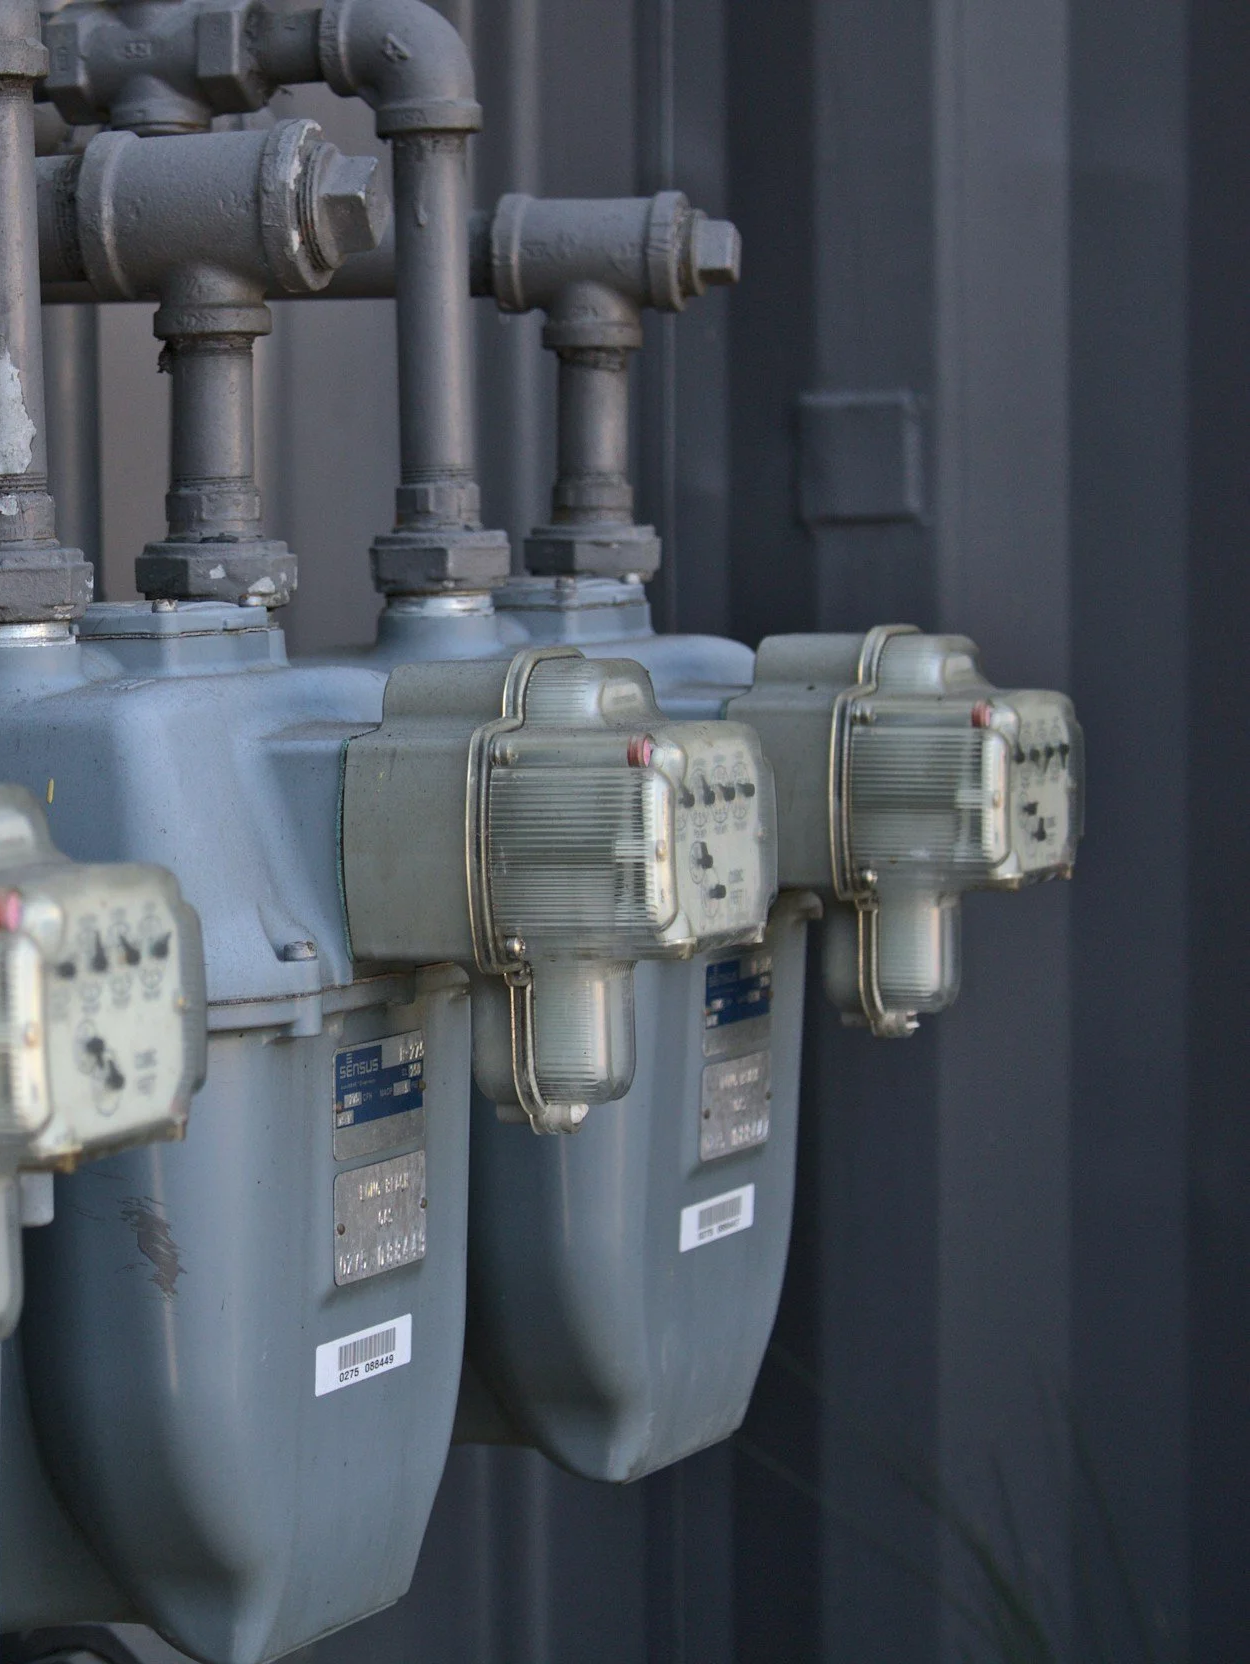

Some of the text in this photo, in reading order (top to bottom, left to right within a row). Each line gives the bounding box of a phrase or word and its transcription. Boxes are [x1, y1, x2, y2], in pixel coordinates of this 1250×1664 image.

[339, 1055, 379, 1079] SENSUS
[339, 1354, 394, 1382] 0275 088449
